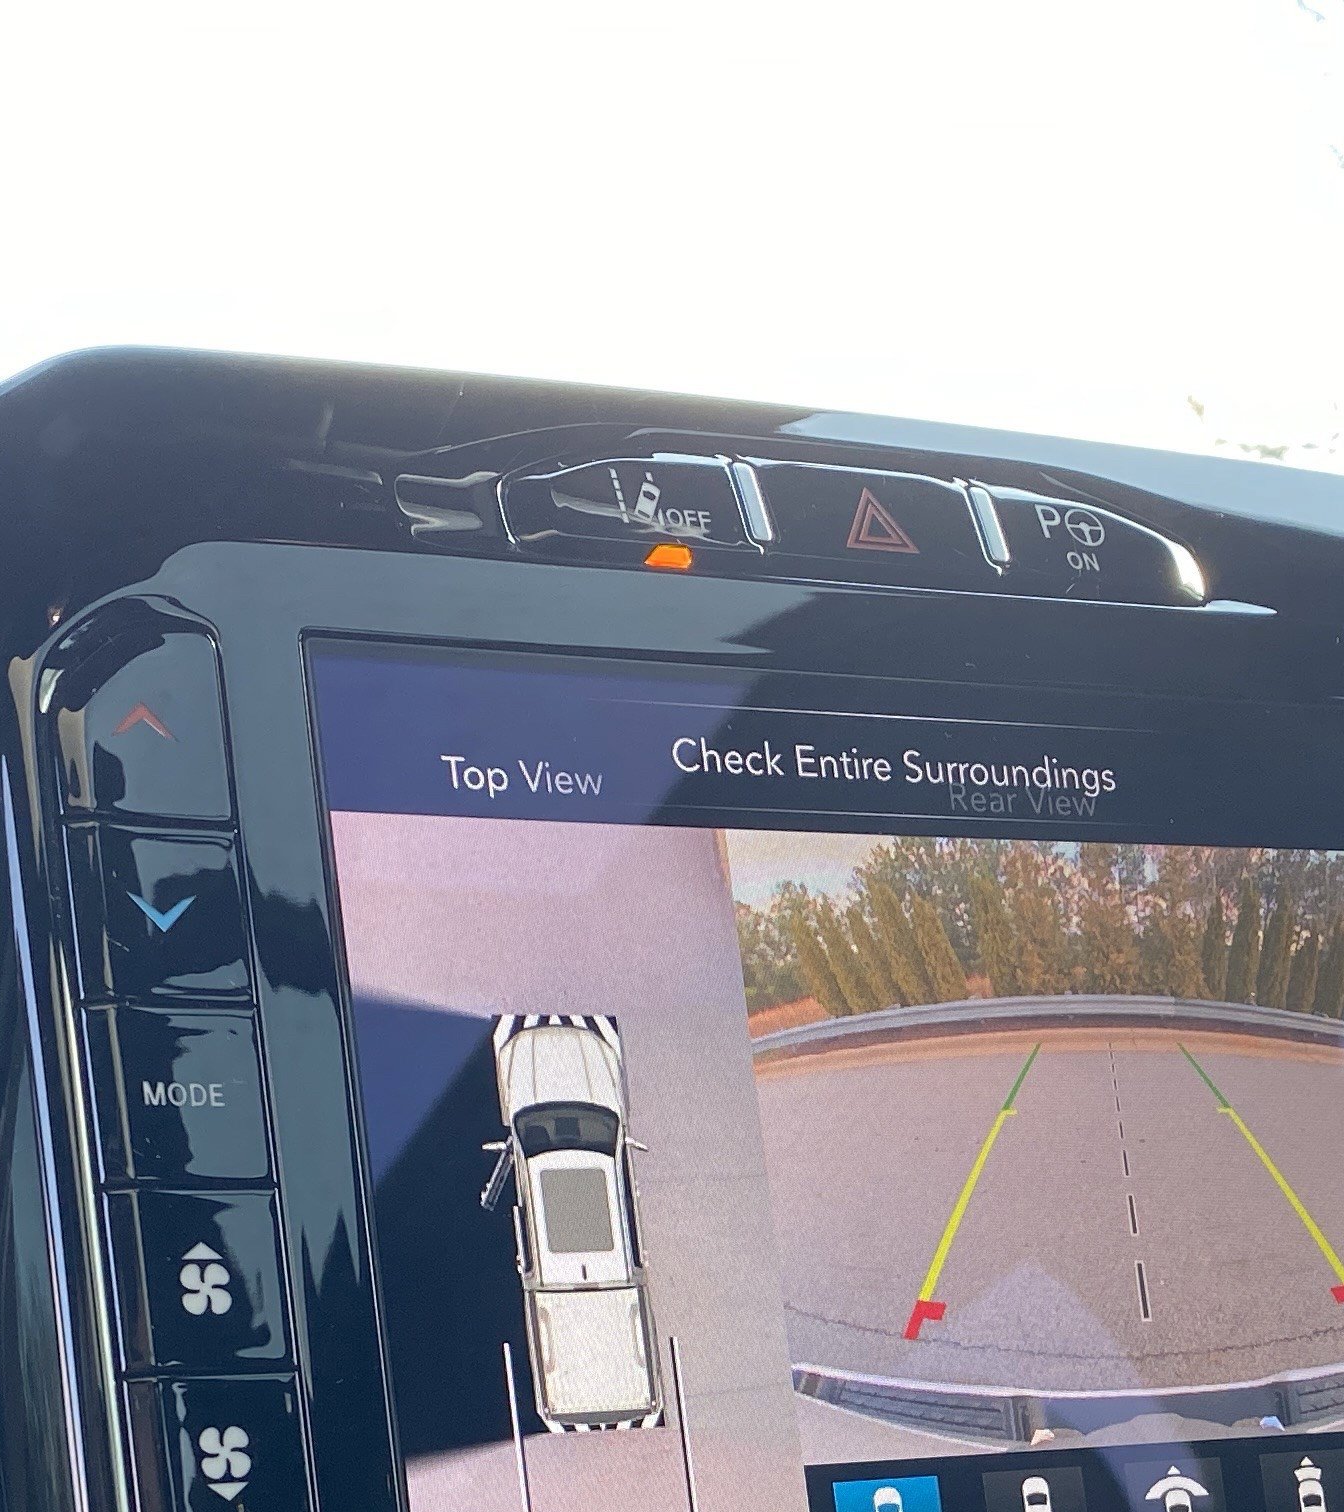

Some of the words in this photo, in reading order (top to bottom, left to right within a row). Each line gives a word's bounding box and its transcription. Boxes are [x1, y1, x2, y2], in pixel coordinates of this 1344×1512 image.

[665, 508, 711, 534] OFF
[1067, 551, 1099, 573] ON
[441, 754, 508, 798] Top
[518, 762, 603, 797] View
[672, 738, 784, 780] Check
[795, 746, 892, 784] Entire
[903, 750, 1118, 798] Surroundings
[950, 783, 1014, 815] Rear
[1024, 787, 1097, 818] View
[142, 1080, 226, 1109] MODE
